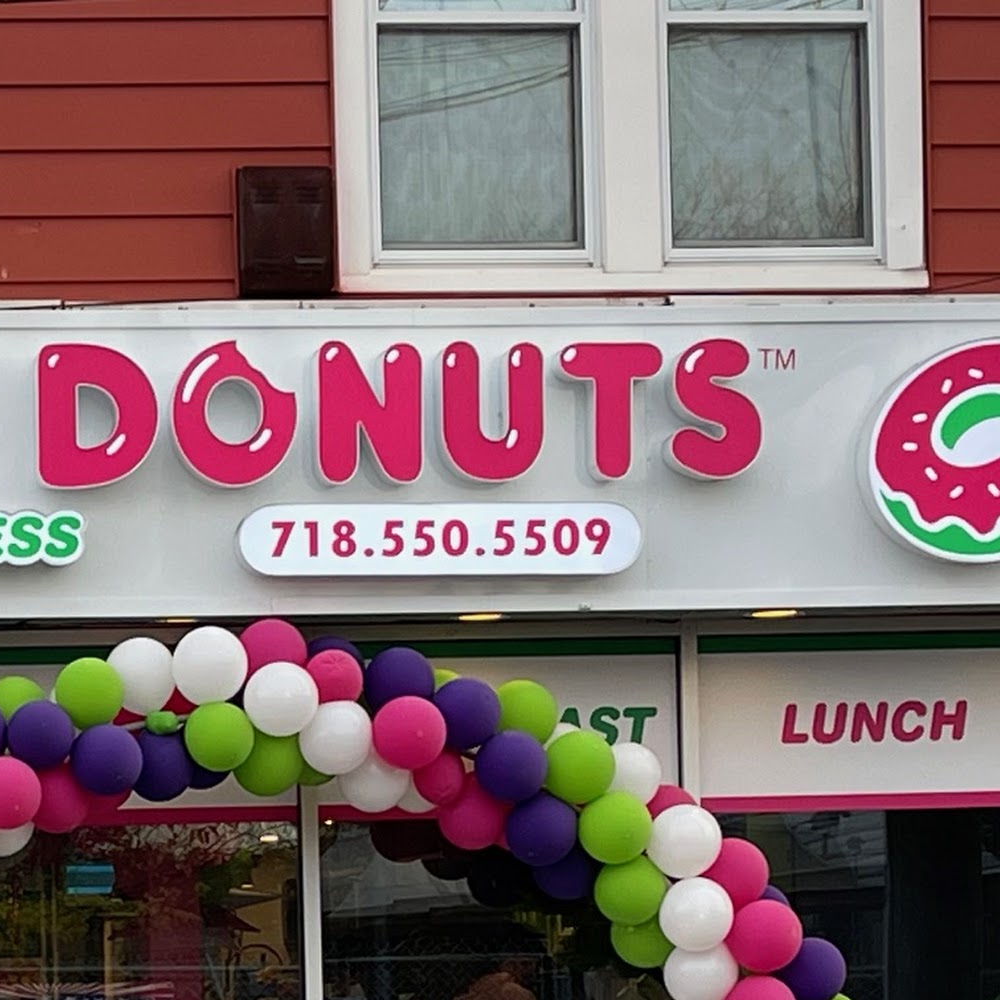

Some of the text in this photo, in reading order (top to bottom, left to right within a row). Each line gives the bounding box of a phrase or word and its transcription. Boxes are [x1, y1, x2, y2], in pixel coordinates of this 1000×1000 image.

[36, 337, 763, 490] DONUTS
[758, 347, 797, 371] TM
[269, 518, 612, 558] 718.550.5509
[780, 699, 969, 745] LUNCH
